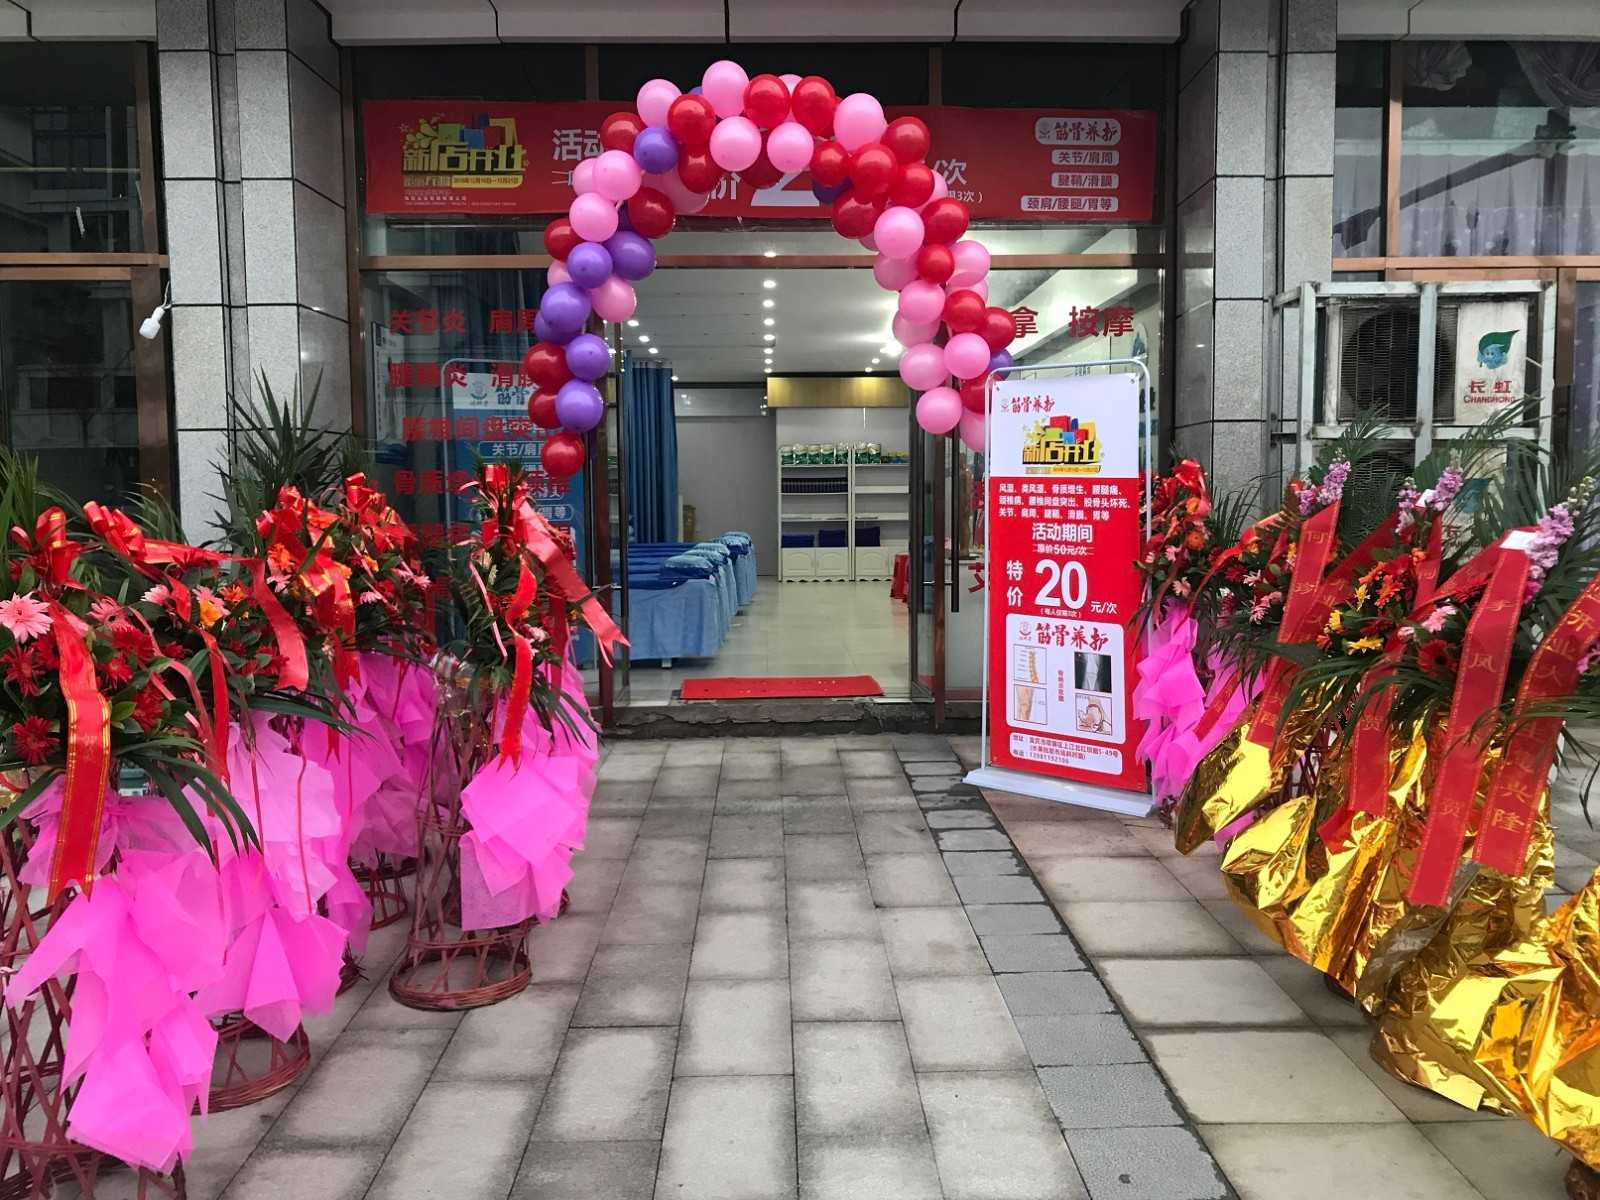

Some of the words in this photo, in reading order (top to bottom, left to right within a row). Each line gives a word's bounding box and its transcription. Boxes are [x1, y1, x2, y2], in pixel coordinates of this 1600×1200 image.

[1058, 151, 1113, 163] 关节/肩周
[1068, 305, 1134, 337] 按摩
[1468, 380, 1512, 394] 长虹
[1463, 395, 1515, 404] CHANGHONG
[1032, 522, 1093, 543] 活动期间
[1034, 558, 1088, 610] 20
[1090, 601, 1118, 615] 元/次
[1036, 622, 1109, 651] 筋骨养护
